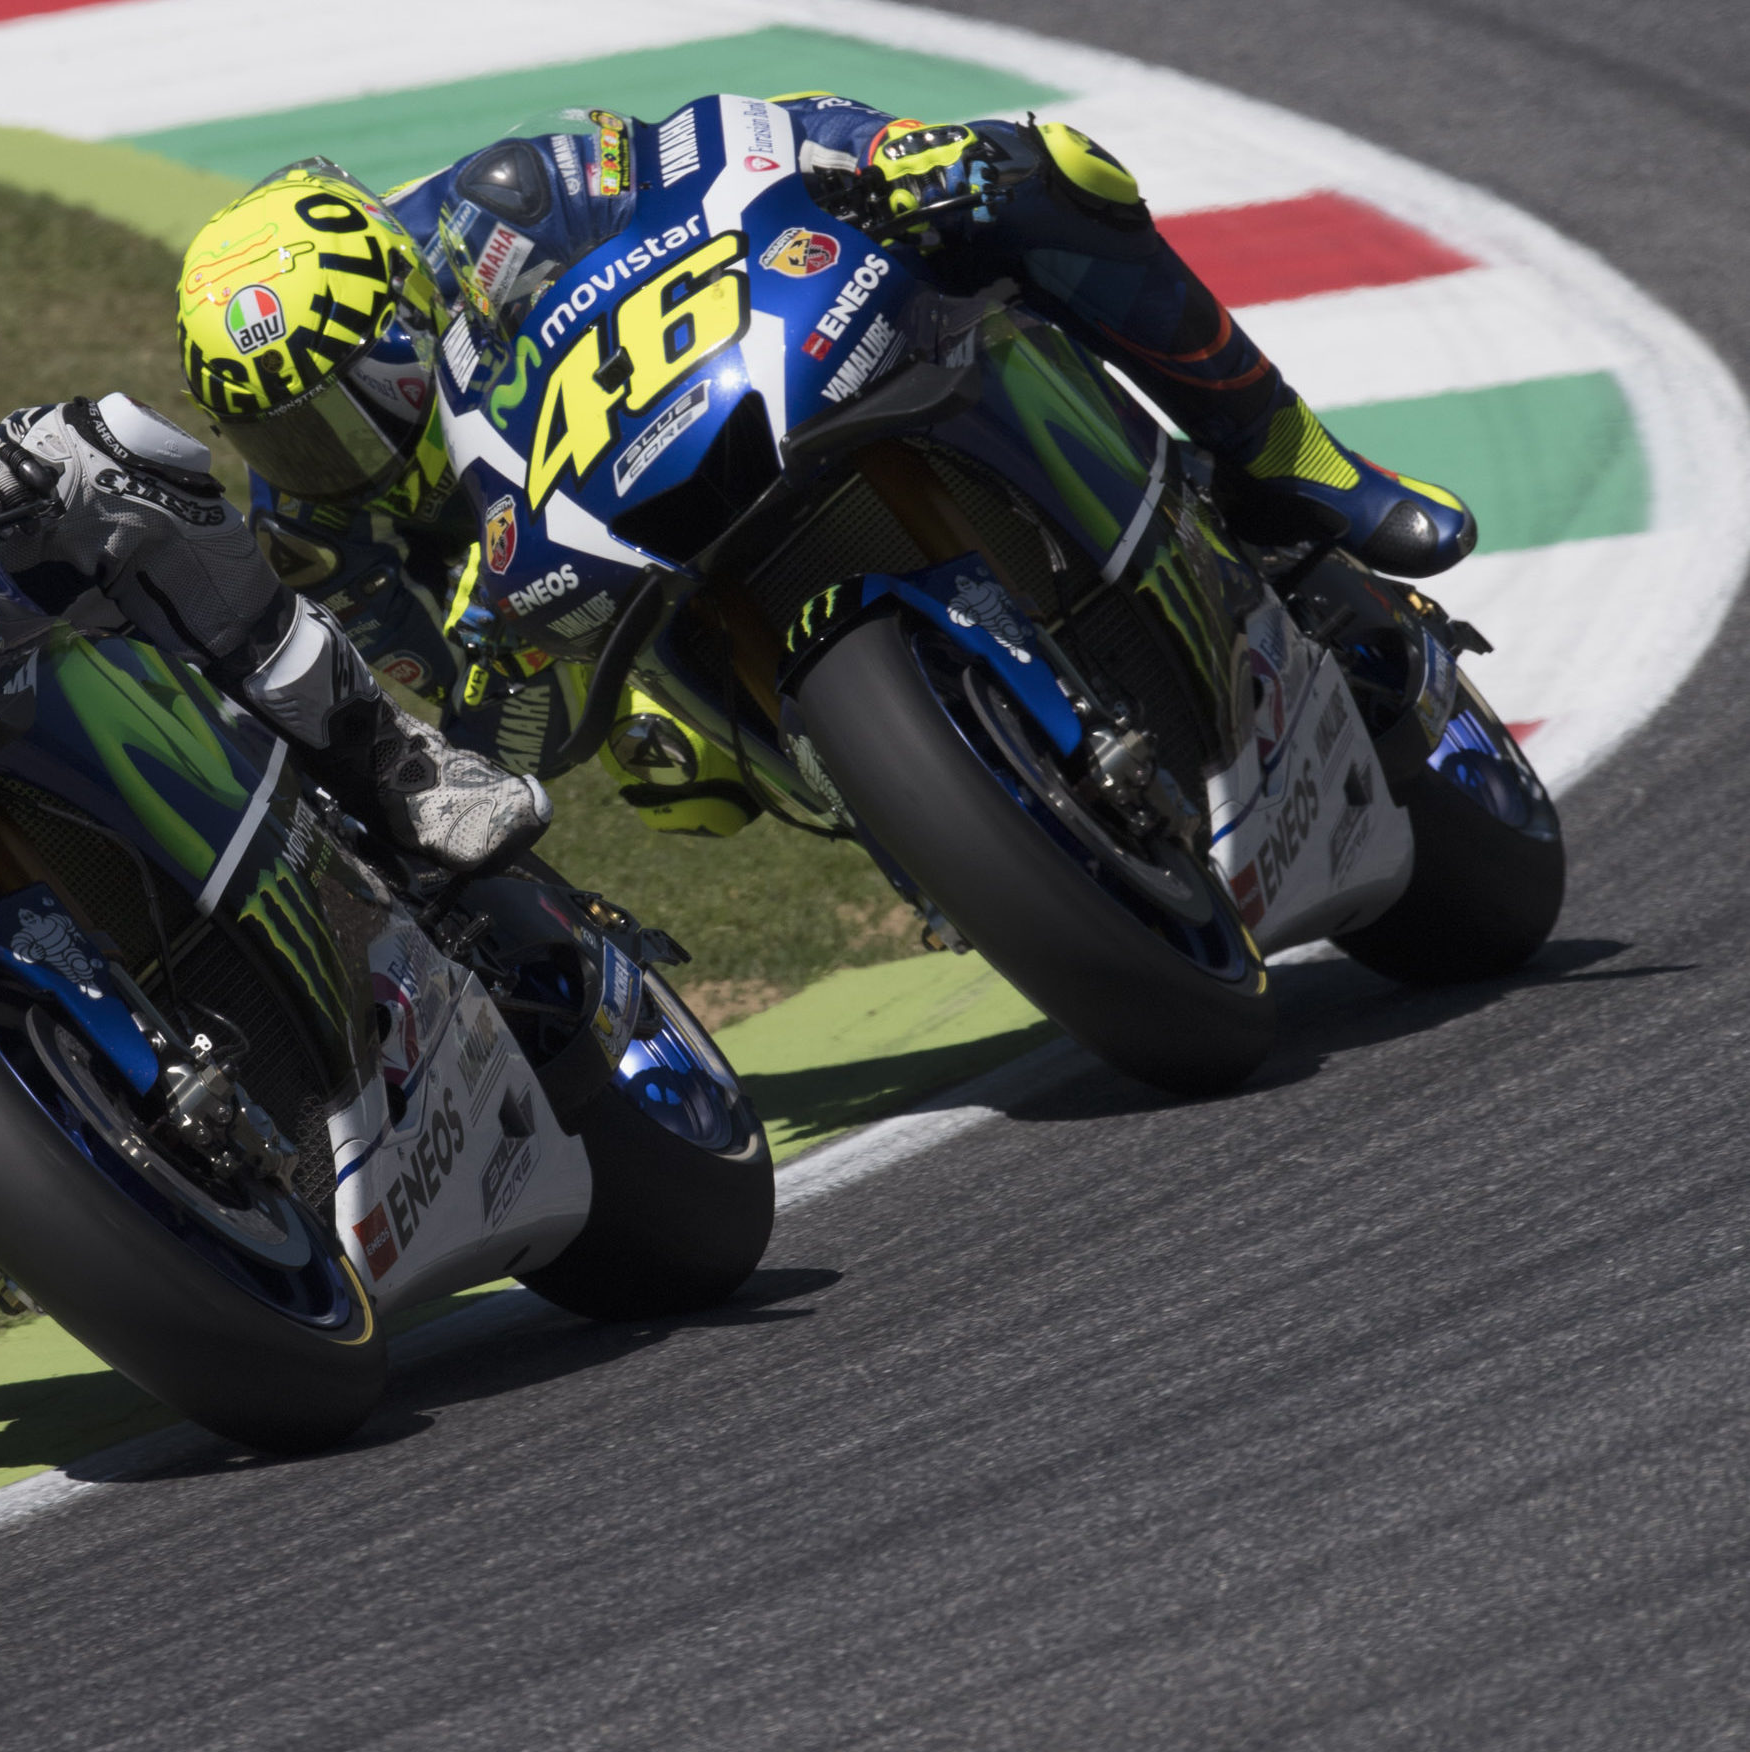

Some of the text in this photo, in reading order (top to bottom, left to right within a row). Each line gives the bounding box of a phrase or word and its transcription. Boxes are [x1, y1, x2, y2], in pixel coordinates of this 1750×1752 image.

[659, 107, 700, 188] YAMAHA
[476, 228, 517, 293] AMAHA
[540, 215, 700, 348] movistar
[816, 254, 890, 341] ENEOS
[239, 315, 280, 350] agv
[526, 231, 749, 515] 46
[820, 312, 896, 403] YAMALUBE
[626, 393, 695, 463] BLUE
[629, 411, 695, 480] CORE
[508, 563, 579, 616] ENEOS
[1256, 759, 1320, 905] ENEOS
[386, 1087, 464, 1251] ENEOS
[365, 1228, 391, 1257] ENEOS
